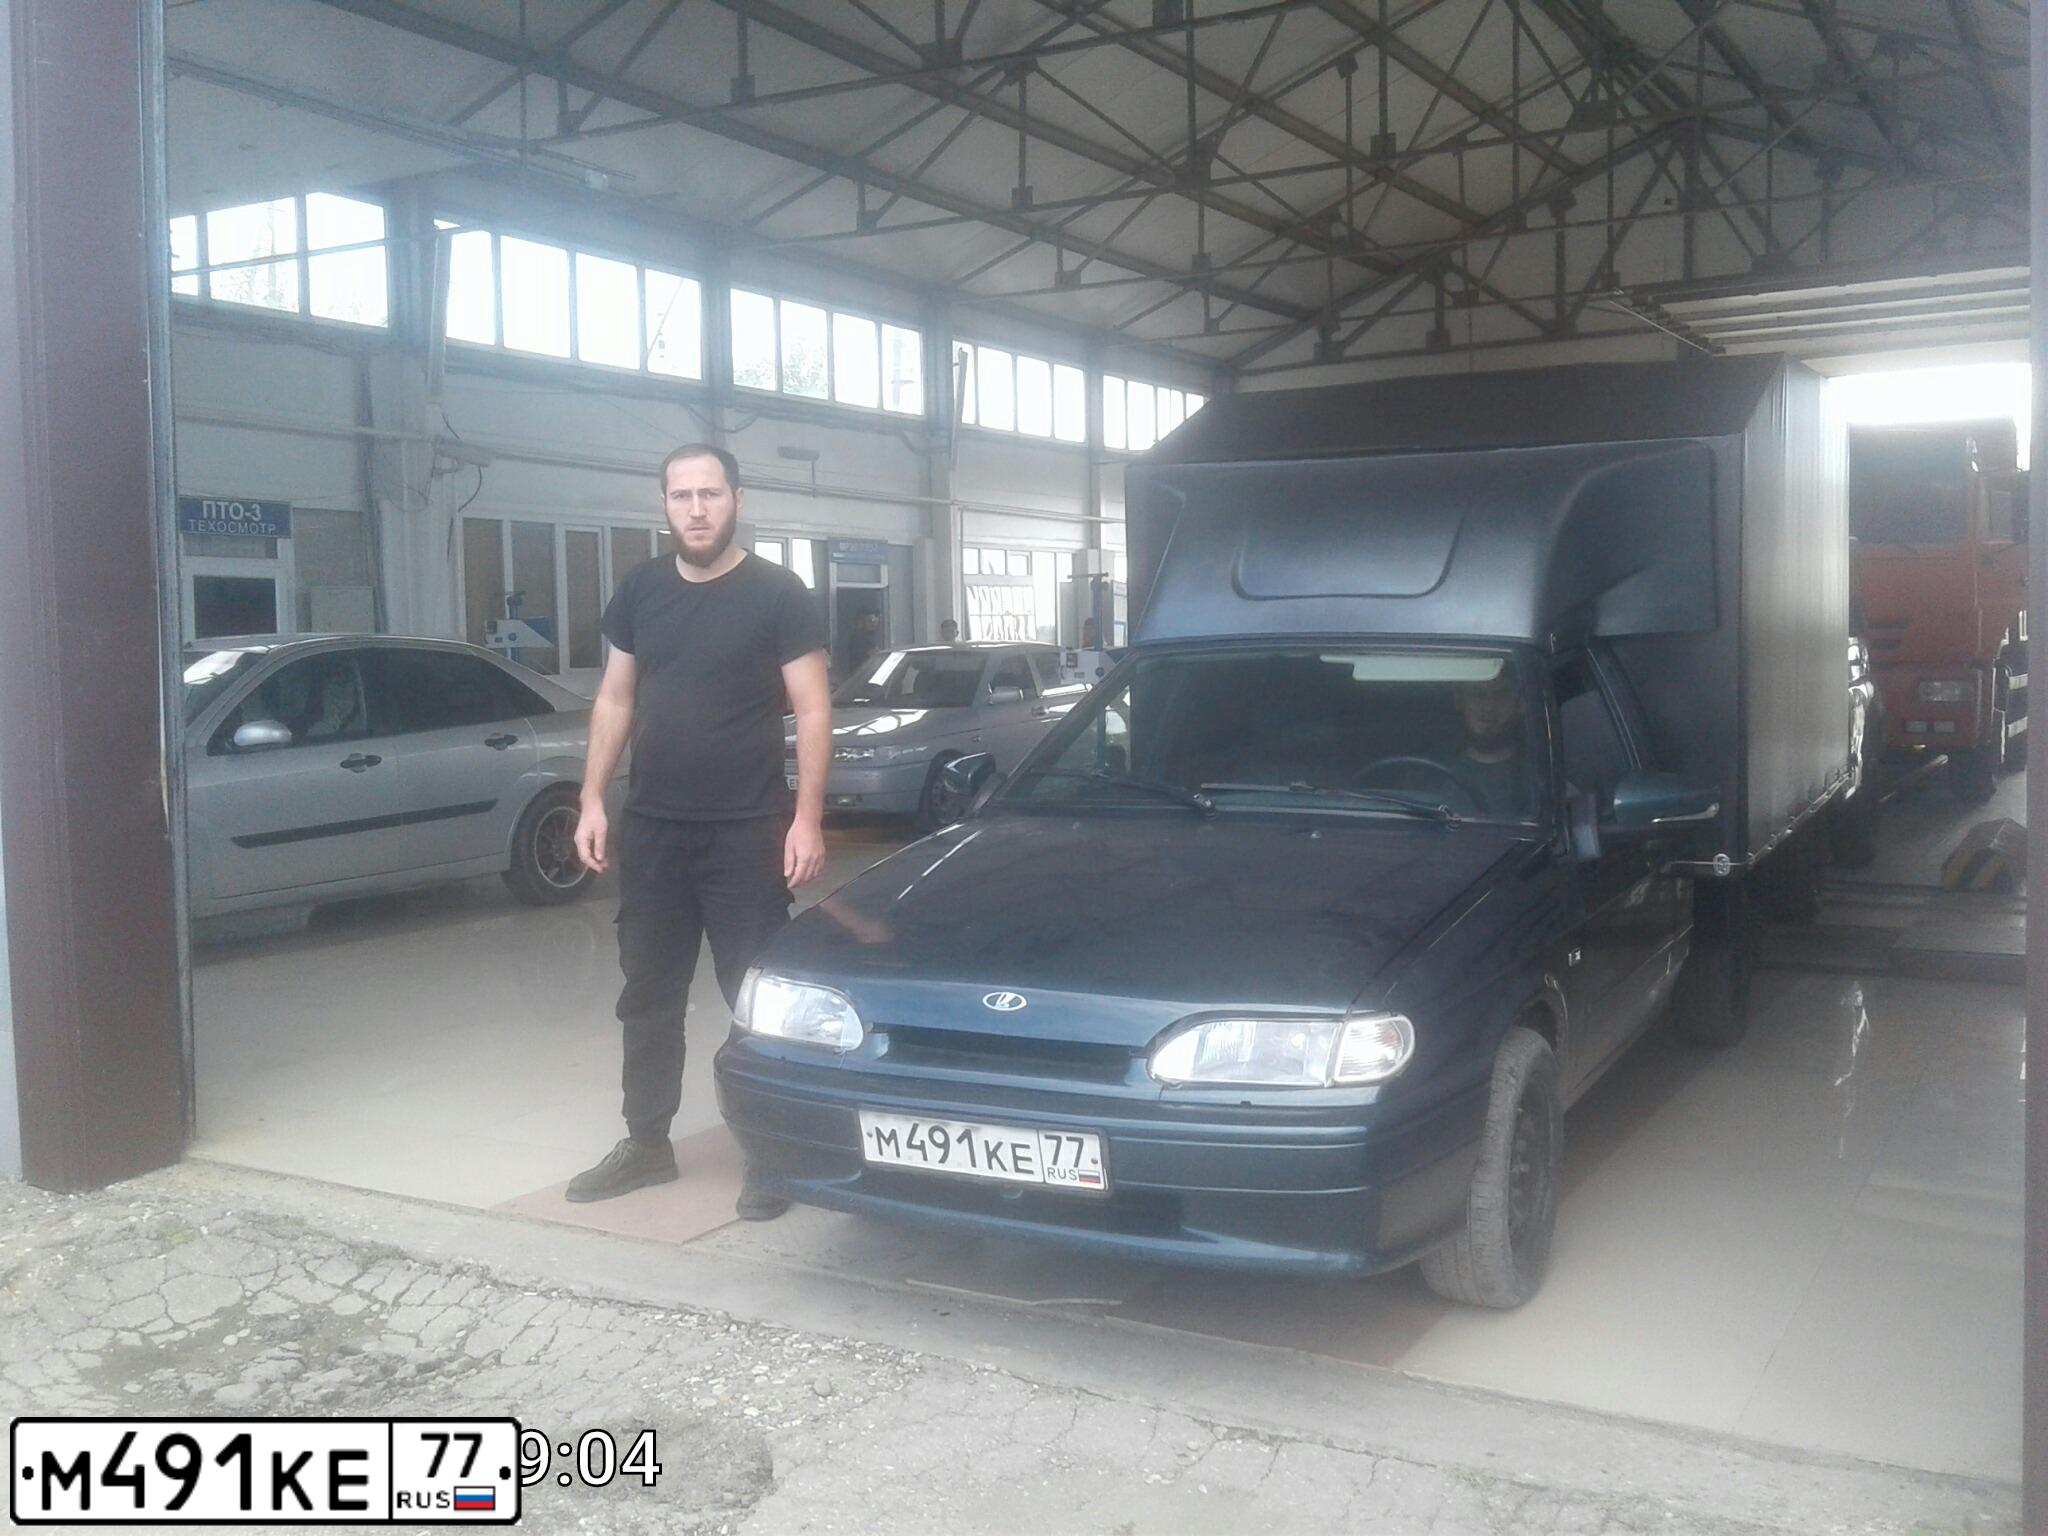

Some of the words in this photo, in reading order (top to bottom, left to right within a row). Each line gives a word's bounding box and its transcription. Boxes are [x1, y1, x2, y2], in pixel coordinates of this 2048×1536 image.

[202, 500, 262, 521] ПТО-3
[188, 519, 277, 535] ТЕХОСМОТР
[1044, 1134, 1084, 1168] 77
[1047, 1167, 1078, 1181] RUS
